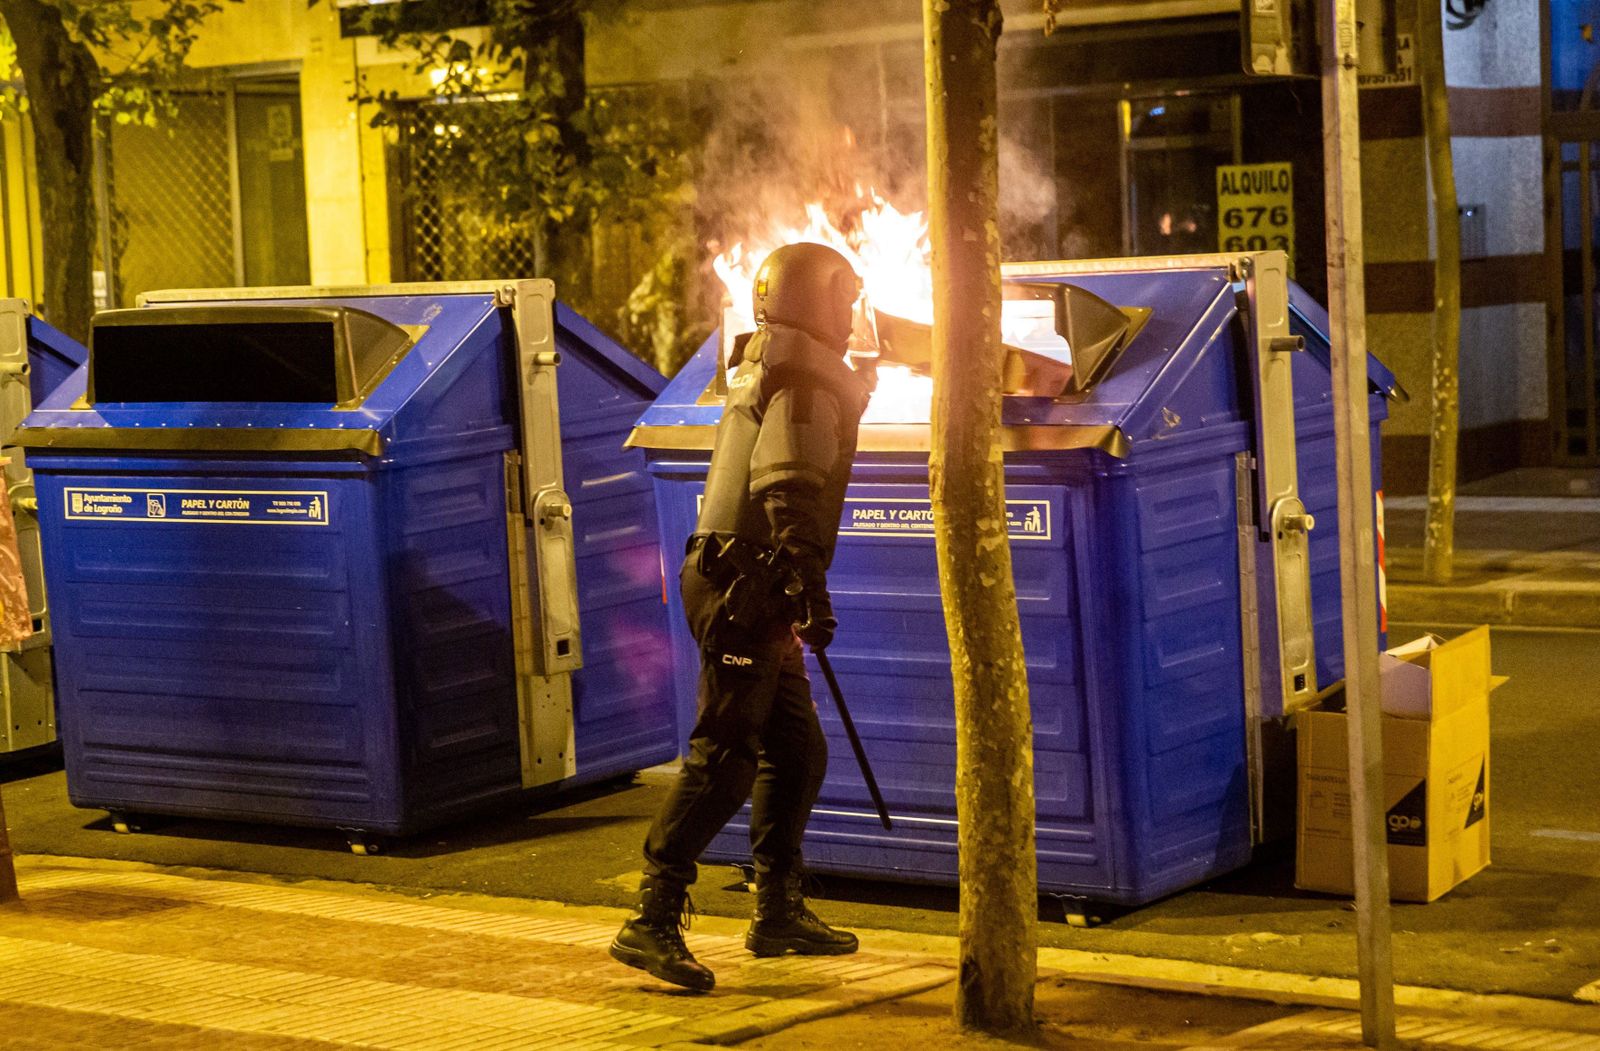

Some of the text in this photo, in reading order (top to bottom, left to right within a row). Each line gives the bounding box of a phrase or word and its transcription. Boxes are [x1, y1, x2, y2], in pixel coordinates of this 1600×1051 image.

[1220, 169, 1290, 195] ALQUILO
[1223, 206, 1288, 229] 676
[83, 493, 132, 504] Ayuntamiento
[181, 497, 250, 509] PAPEL Y CARTÓN
[83, 504, 123, 515] de Logroño
[852, 508, 935, 521] PAPEL Y CARTÓ
[722, 654, 753, 666] CNP
